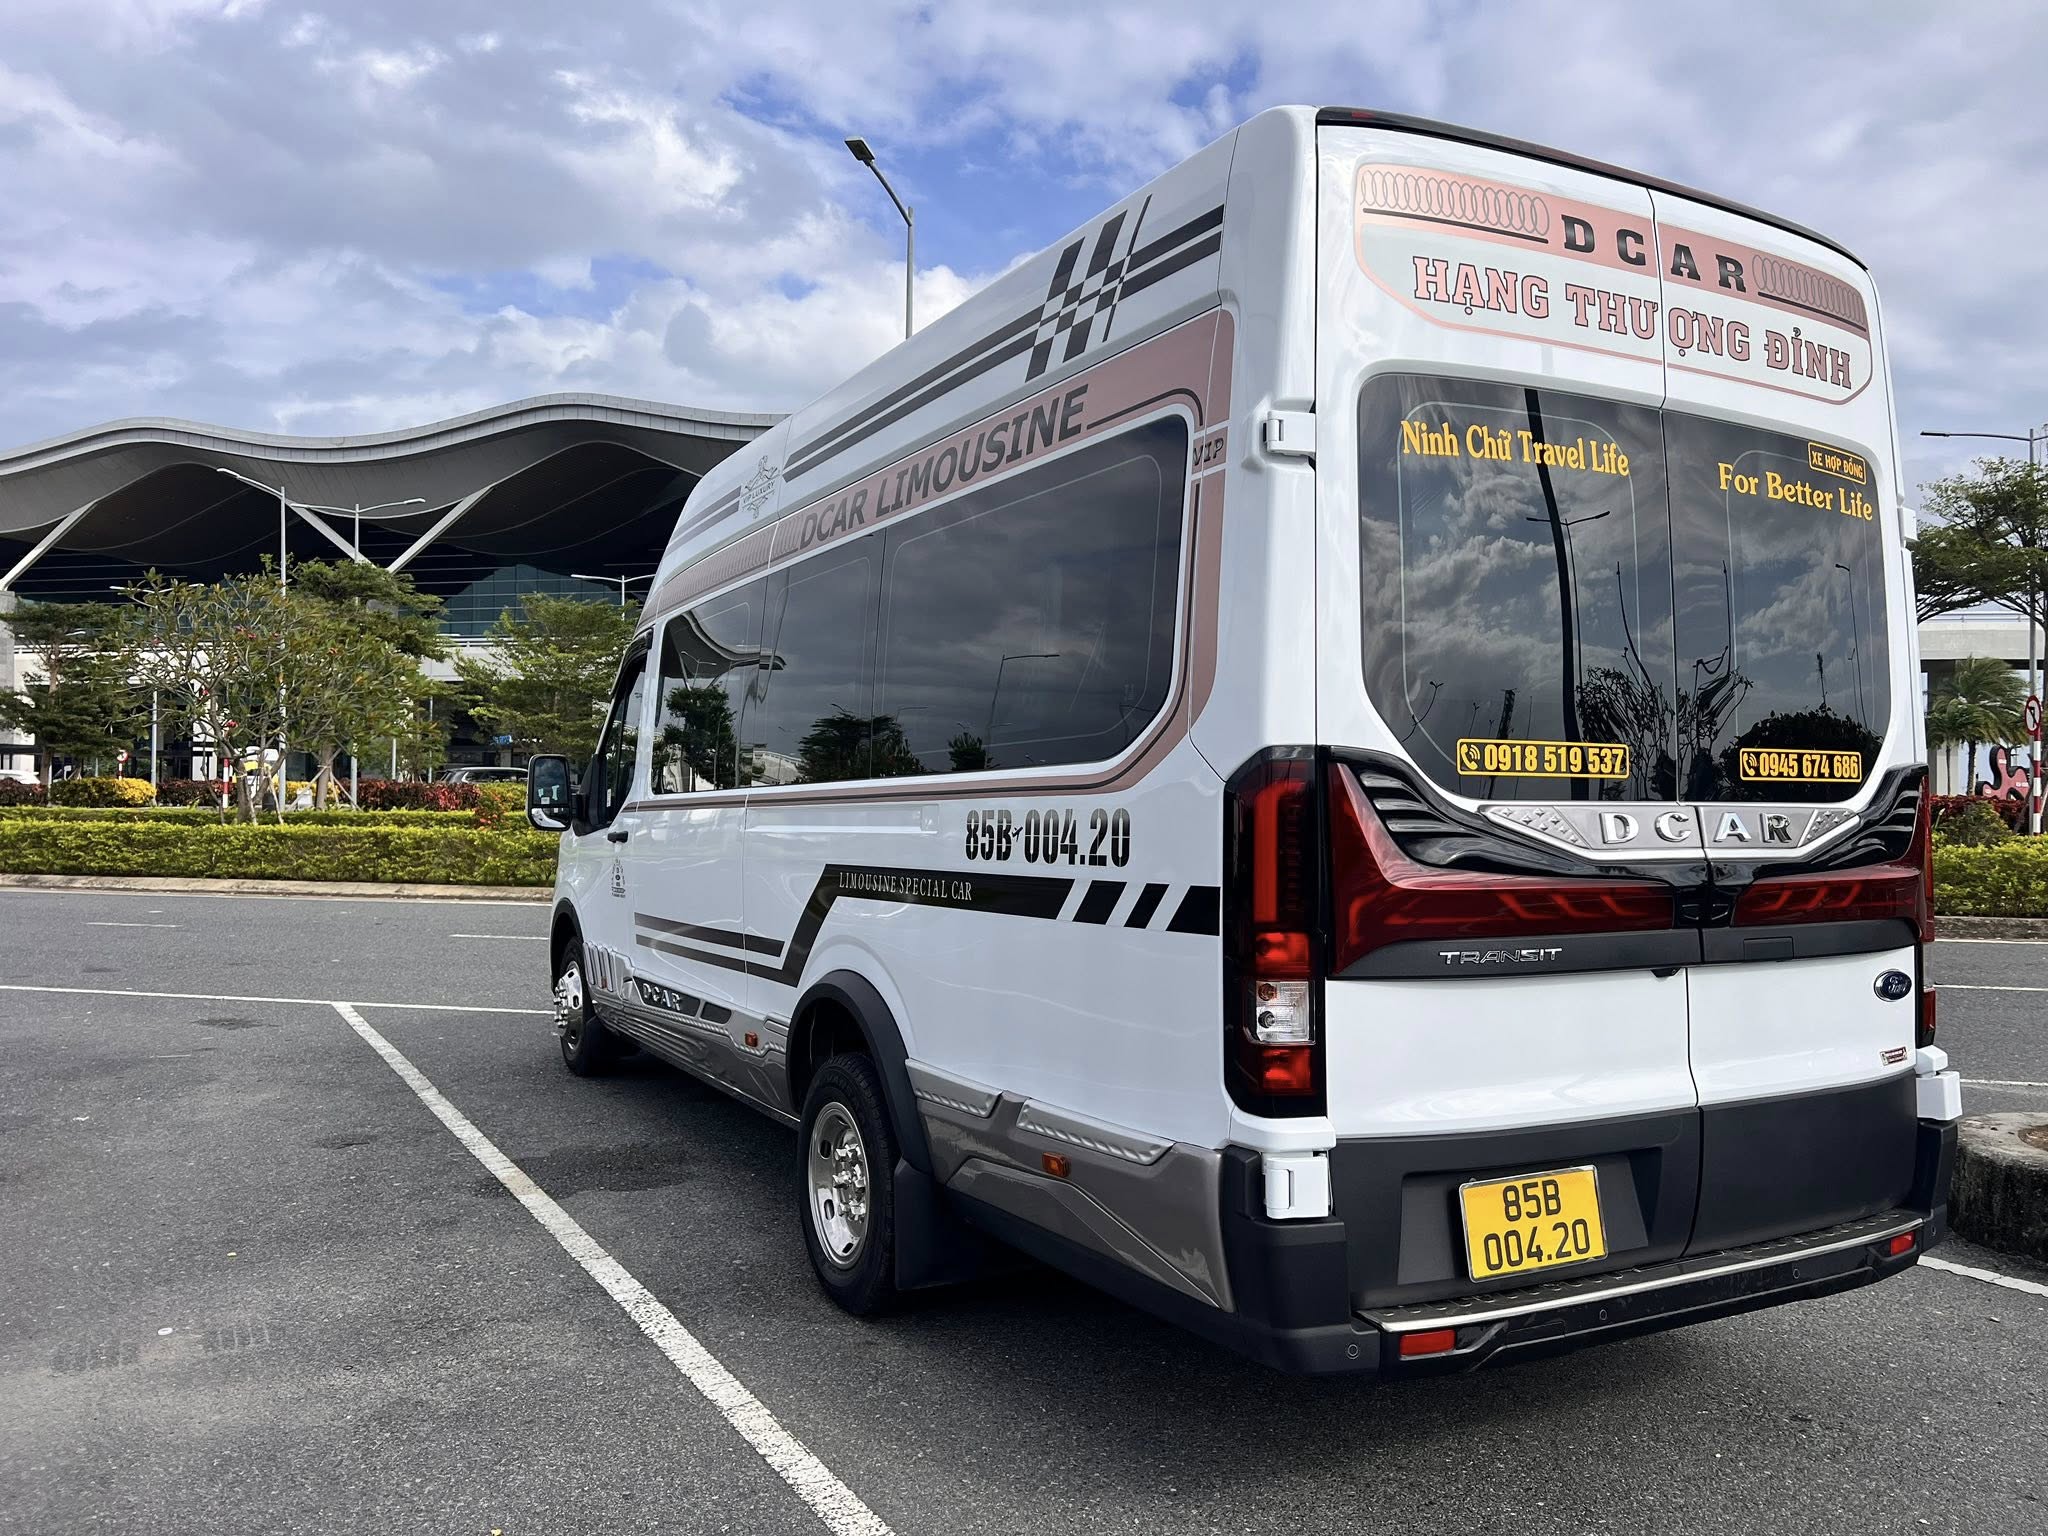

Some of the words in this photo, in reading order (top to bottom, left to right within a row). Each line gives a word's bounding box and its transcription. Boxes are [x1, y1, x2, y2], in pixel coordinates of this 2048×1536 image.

[1561, 213, 1747, 293] DCAR
[1412, 255, 1549, 319] HẠNG
[1565, 282, 1750, 362] THƯỢNG
[1764, 327, 1851, 389] ĐỈNH
[799, 489, 868, 548] DCAR
[876, 383, 1089, 519] LIMOUSINE
[1193, 437, 1224, 466] VIP
[1401, 420, 1460, 457] Ninh
[1465, 424, 1512, 461] Chữ
[1517, 430, 1586, 470] Travel
[1589, 439, 1630, 477] Life
[1812, 451, 1823, 466] XE
[1825, 454, 1841, 472] HỢP
[1718, 462, 1758, 497] For
[1765, 471, 1834, 510] Better
[1839, 487, 1873, 521] Life
[1484, 745, 1537, 772] 0918
[1543, 746, 1582, 774] 519
[1586, 748, 1625, 775] 537
[1758, 754, 1798, 778] 0945
[1802, 755, 1830, 779] 674
[1833, 756, 1859, 780] 686
[1024, 807, 1130, 867] 004.20
[1599, 811, 1795, 845] DCAR
[839, 872, 896, 893] LIMOUSINE
[899, 876, 947, 898] SPECIAL
[951, 880, 972, 901] CAR
[1439, 947, 1562, 965] TRANSIT
[643, 983, 680, 1011] DCAR
[1503, 1179, 1562, 1222] 85B
[1483, 1218, 1590, 1271] 004.20
